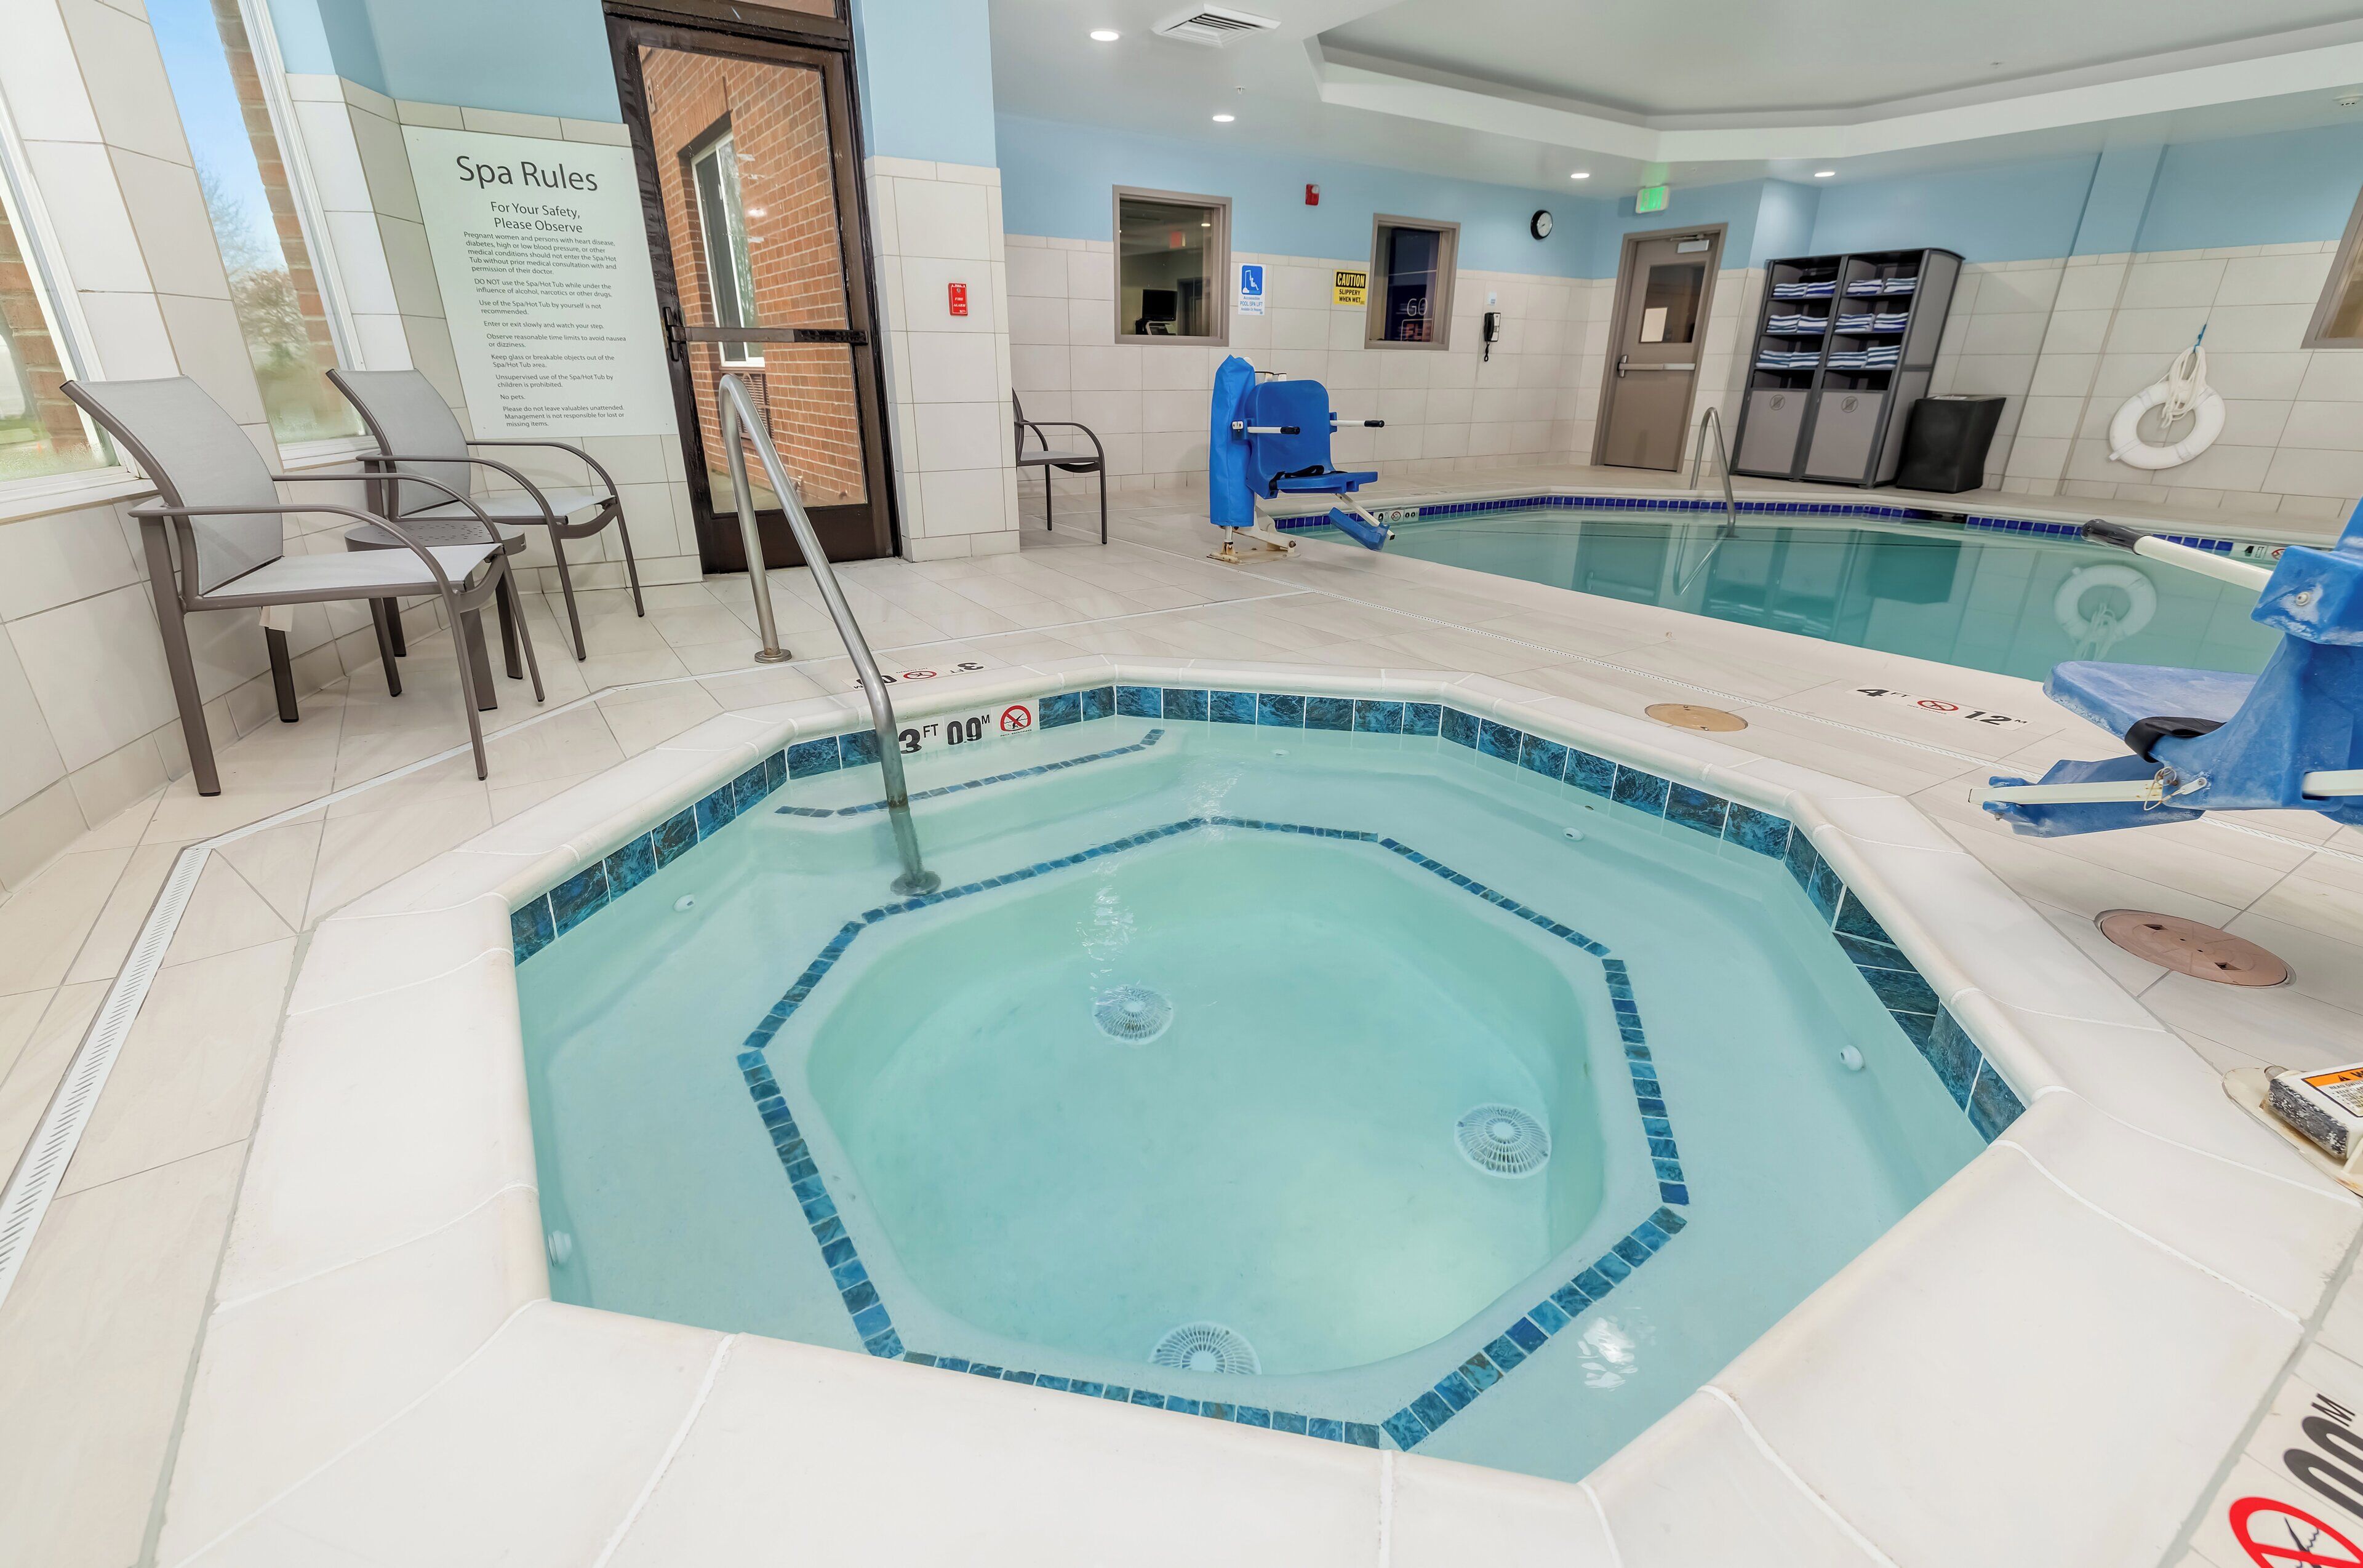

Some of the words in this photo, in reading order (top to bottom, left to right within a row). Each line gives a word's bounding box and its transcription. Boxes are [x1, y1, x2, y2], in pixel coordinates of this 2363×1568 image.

[456, 156, 513, 189] Spa
[521, 161, 598, 191] Rules
[490, 201, 510, 212] For
[511, 202, 539, 215] Your
[542, 205, 580, 219] Safety,
[494, 217, 532, 230] Please
[535, 219, 583, 233] Observe
[464, 231, 494, 239] Pregnant
[1337, 273, 1365, 287] CAUTION
[1407, 298, 1428, 316] GO
[1857, 689, 1890, 697] 4
[1964, 711, 2012, 726] 1.2
[898, 728, 922, 754] 3
[923, 723, 939, 738] FT
[981, 714, 991, 726] M
